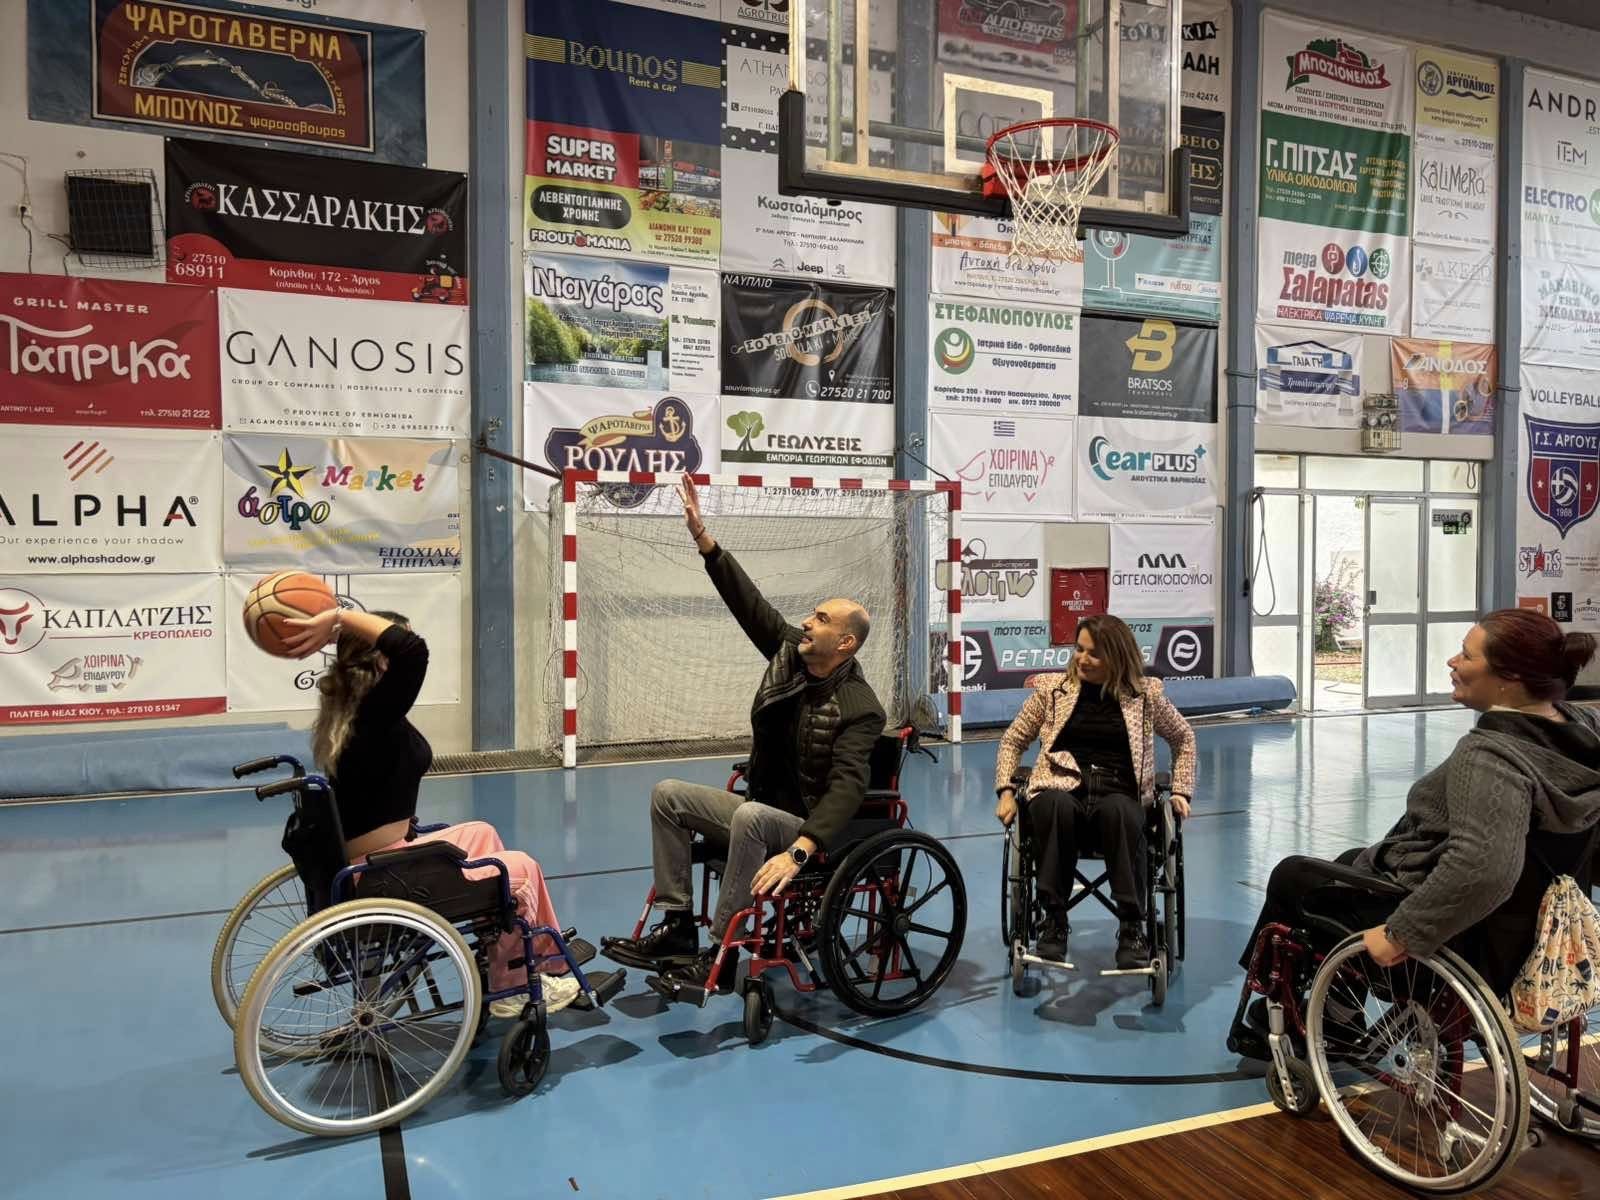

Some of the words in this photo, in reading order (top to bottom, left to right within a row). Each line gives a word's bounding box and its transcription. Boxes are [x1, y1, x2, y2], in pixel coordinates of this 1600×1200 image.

[125, 2, 341, 61] ΨΑΡΟΤΑΒΕΡΝΑ
[1299, 53, 1381, 84] ΜΠΟΖΙΟΝΕΛΟΣ
[628, 76, 651, 89] Rent
[661, 83, 677, 93] car
[135, 92, 244, 127] ΜΠΟΥΝΟΣ
[547, 136, 616, 162] SUPER
[1266, 137, 1358, 181] Γ.ΠΙΤΣΑΣ
[546, 160, 617, 181] MARKET
[1266, 167, 1295, 184] ΥΛΙΚΑ
[1296, 171, 1358, 194] ΟΙΚΟΔΟΜΩΝ
[539, 191, 624, 212] ΛΕΒΕΝΤΟΓΙΑΝΝΗΣ
[1524, 185, 1588, 213] ELECTRO
[216, 183, 426, 235] ΚΑΣΣΑΡΑΚΗΣ
[562, 207, 601, 222] ΧΡΟΝΗΣ
[757, 195, 863, 224] Κωσταλάμπρος
[191, 253, 226, 265] 27510
[797, 261, 824, 274] Jeep
[1283, 250, 1317, 268] mega
[175, 262, 224, 280] 68911
[321, 272, 341, 282] 172
[532, 266, 664, 313] Νιαγάρας
[723, 274, 773, 288] ΝΑΥΠΛΙΟ
[13, 297, 69, 309] GRILL
[77, 301, 150, 314] MASTER
[935, 303, 1073, 330] ΣΤΕΦΑΝΟΠΟΥΛΟΣ
[226, 330, 464, 376] GANOSIS
[284, 381, 335, 390] COMPANIES
[1128, 377, 1173, 392] BRATSOS
[820, 387, 854, 398] 27520
[855, 388, 867, 399] 21
[872, 388, 891, 400] 700
[192, 410, 210, 419] 222
[292, 409, 340, 417] PROVINCE
[766, 434, 862, 451] ΓΕΩΛΥΣΕΙΣ
[1555, 433, 1598, 449] ΑΡΓΟΥΣ
[563, 446, 688, 473] ΡΟΥΛΗΣ
[766, 454, 803, 463] ΕΜΠΟΡΙΑ
[805, 455, 849, 465] ΓΕΩΡΓΙΚΩΝ
[851, 456, 887, 465] ΕΦΟΔΙΩΝ
[989, 448, 1039, 471] ΧΟΙΡΙΝΑ
[321, 464, 425, 492] Market
[988, 473, 1039, 488] ΕΠΙΔΑΥΡΟΥ
[25, 536, 98, 546] experience
[104, 537, 132, 546] your
[136, 536, 184, 545] shadow
[27, 554, 156, 565] www.alphashadow.gr
[42, 605, 213, 630] ΚΑΠΛΑΤΖΗΣ
[133, 628, 213, 641] ΚΡΕΟΠΩΛΕΙΟ
[994, 626, 1021, 636] MOTO
[1024, 626, 1047, 636] TECH
[83, 654, 126, 669] ΧΟΙΡΙΝΑ
[83, 671, 126, 680] ΕΠΙΔΑΥΡΟΥ
[9, 711, 50, 719] ΠΛΑΤΕΙΑ
[52, 709, 77, 717] ΝΕΑΣ
[127, 705, 154, 714] 27510
[155, 704, 181, 713] 51347
